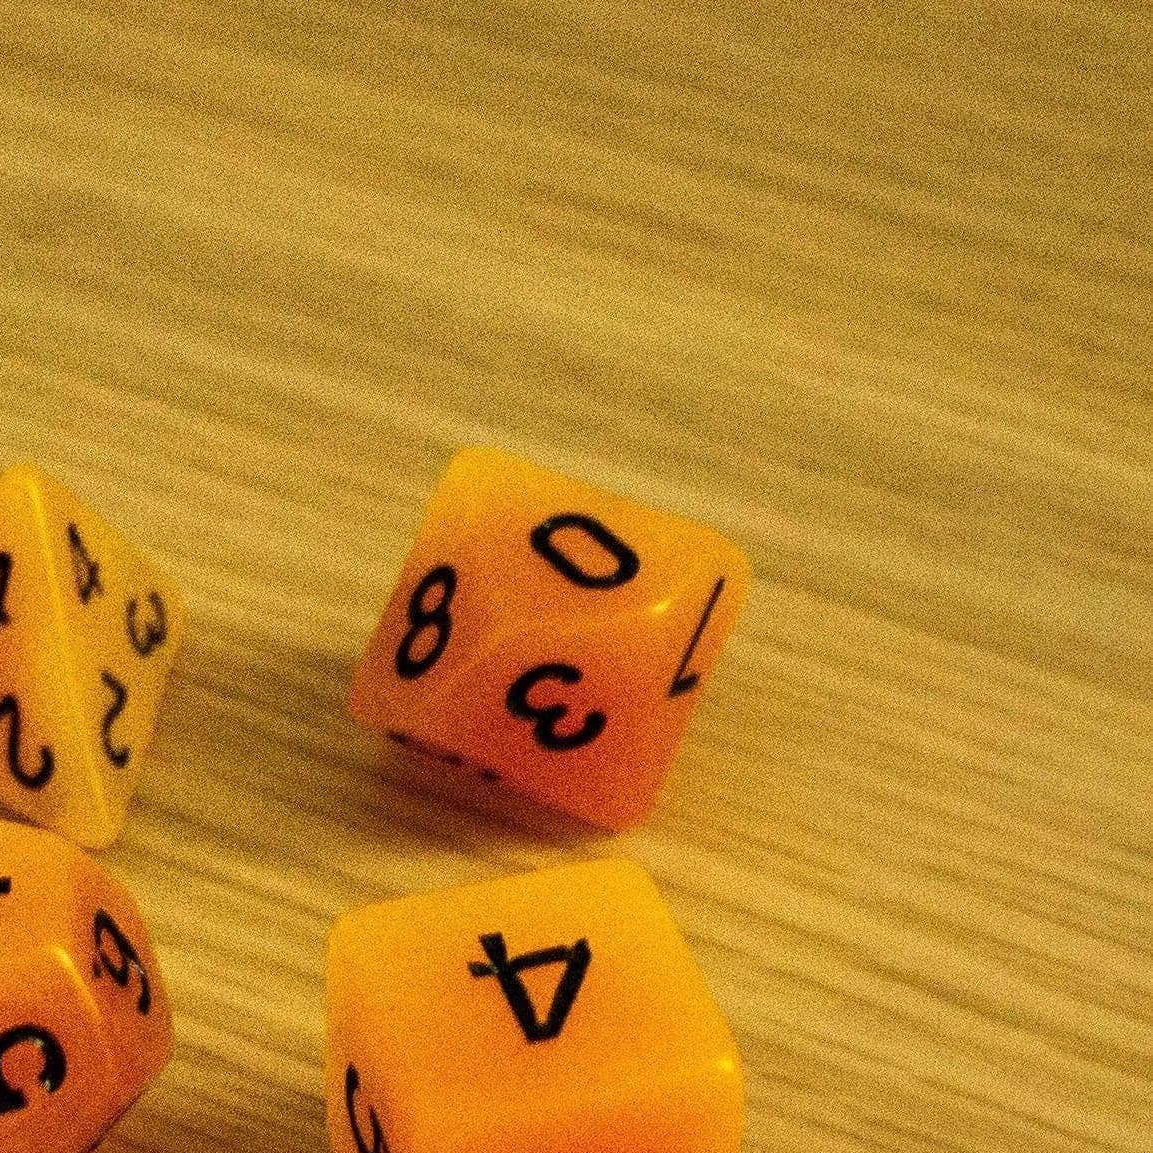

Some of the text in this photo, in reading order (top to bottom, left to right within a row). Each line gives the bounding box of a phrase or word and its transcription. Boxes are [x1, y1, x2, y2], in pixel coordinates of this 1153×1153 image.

[529, 512, 640, 590] 0
[394, 564, 457, 681] 8
[505, 663, 607, 752] 3
[468, 932, 592, 1044] 4
